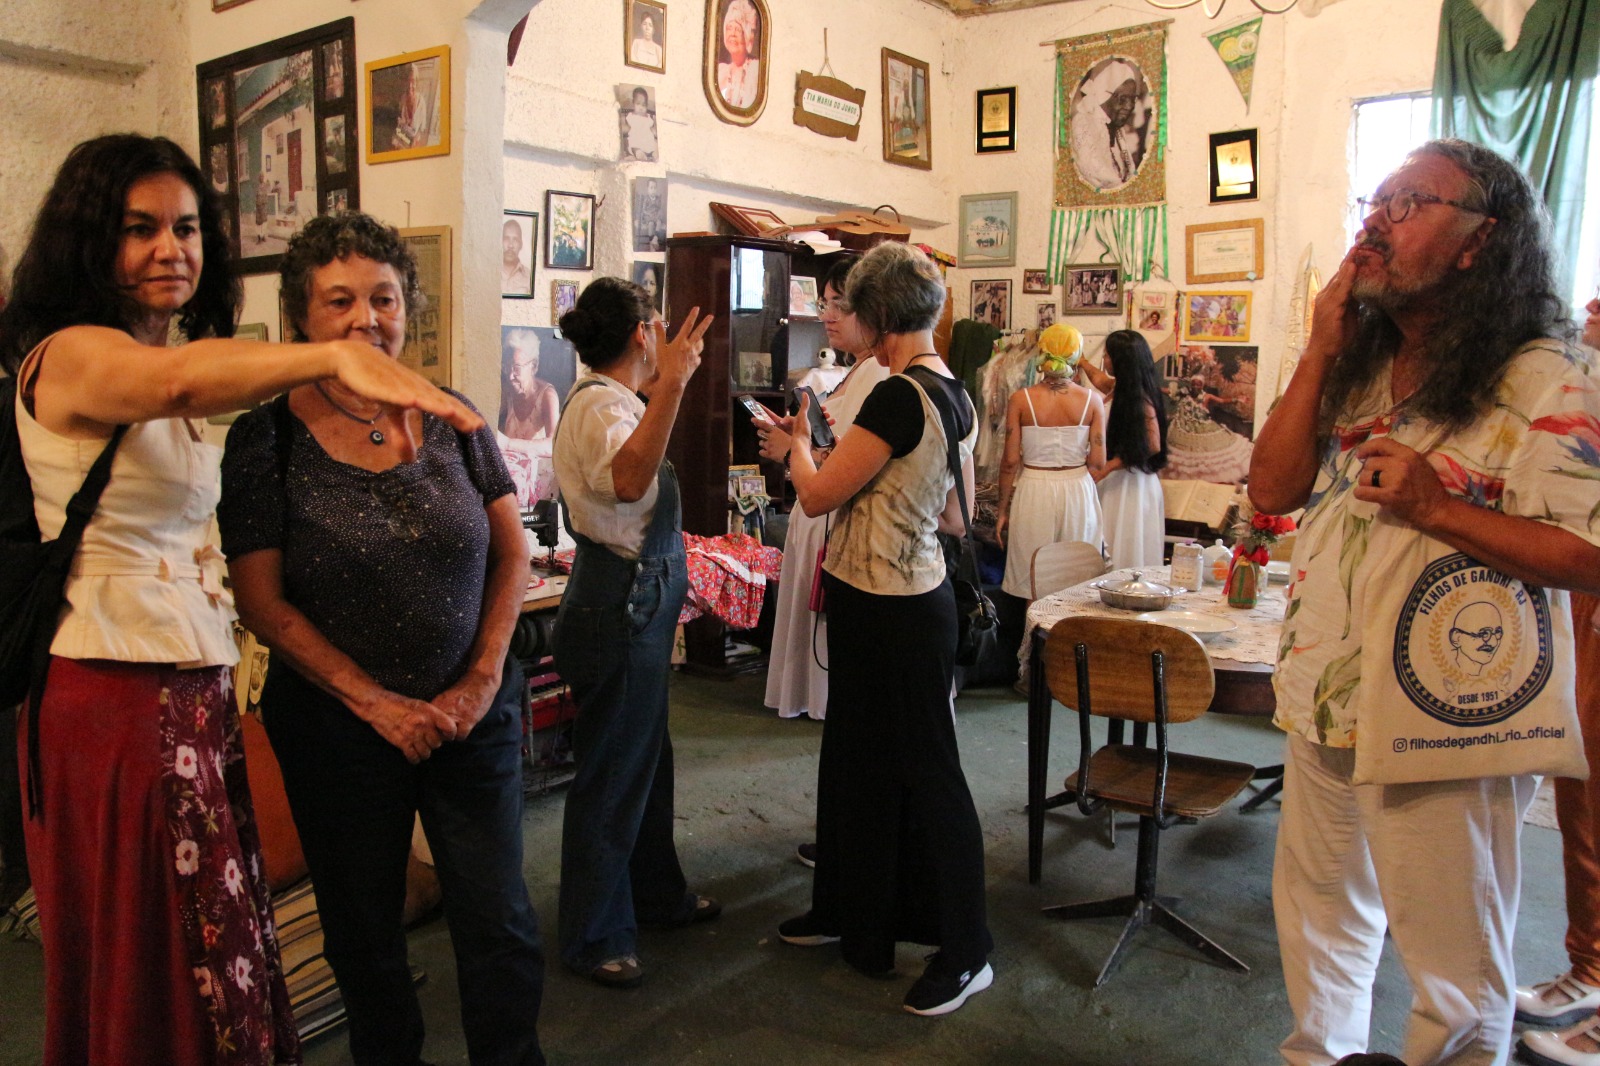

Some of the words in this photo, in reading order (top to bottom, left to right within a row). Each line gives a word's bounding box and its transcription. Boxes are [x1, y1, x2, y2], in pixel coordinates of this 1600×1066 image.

[806, 92, 816, 102] TIA
[816, 95, 833, 107] MARIA
[833, 101, 841, 110] DO
[1420, 580, 1452, 616] FILHOS
[1452, 572, 1468, 588] DE
[1471, 569, 1514, 589] GANDHI
[1515, 589, 1527, 605] RJ
[1457, 692, 1479, 705] DESDE
[1481, 691, 1499, 702] 1951
[1410, 727, 1565, 750] filhosdegandhi_rio_oficial
